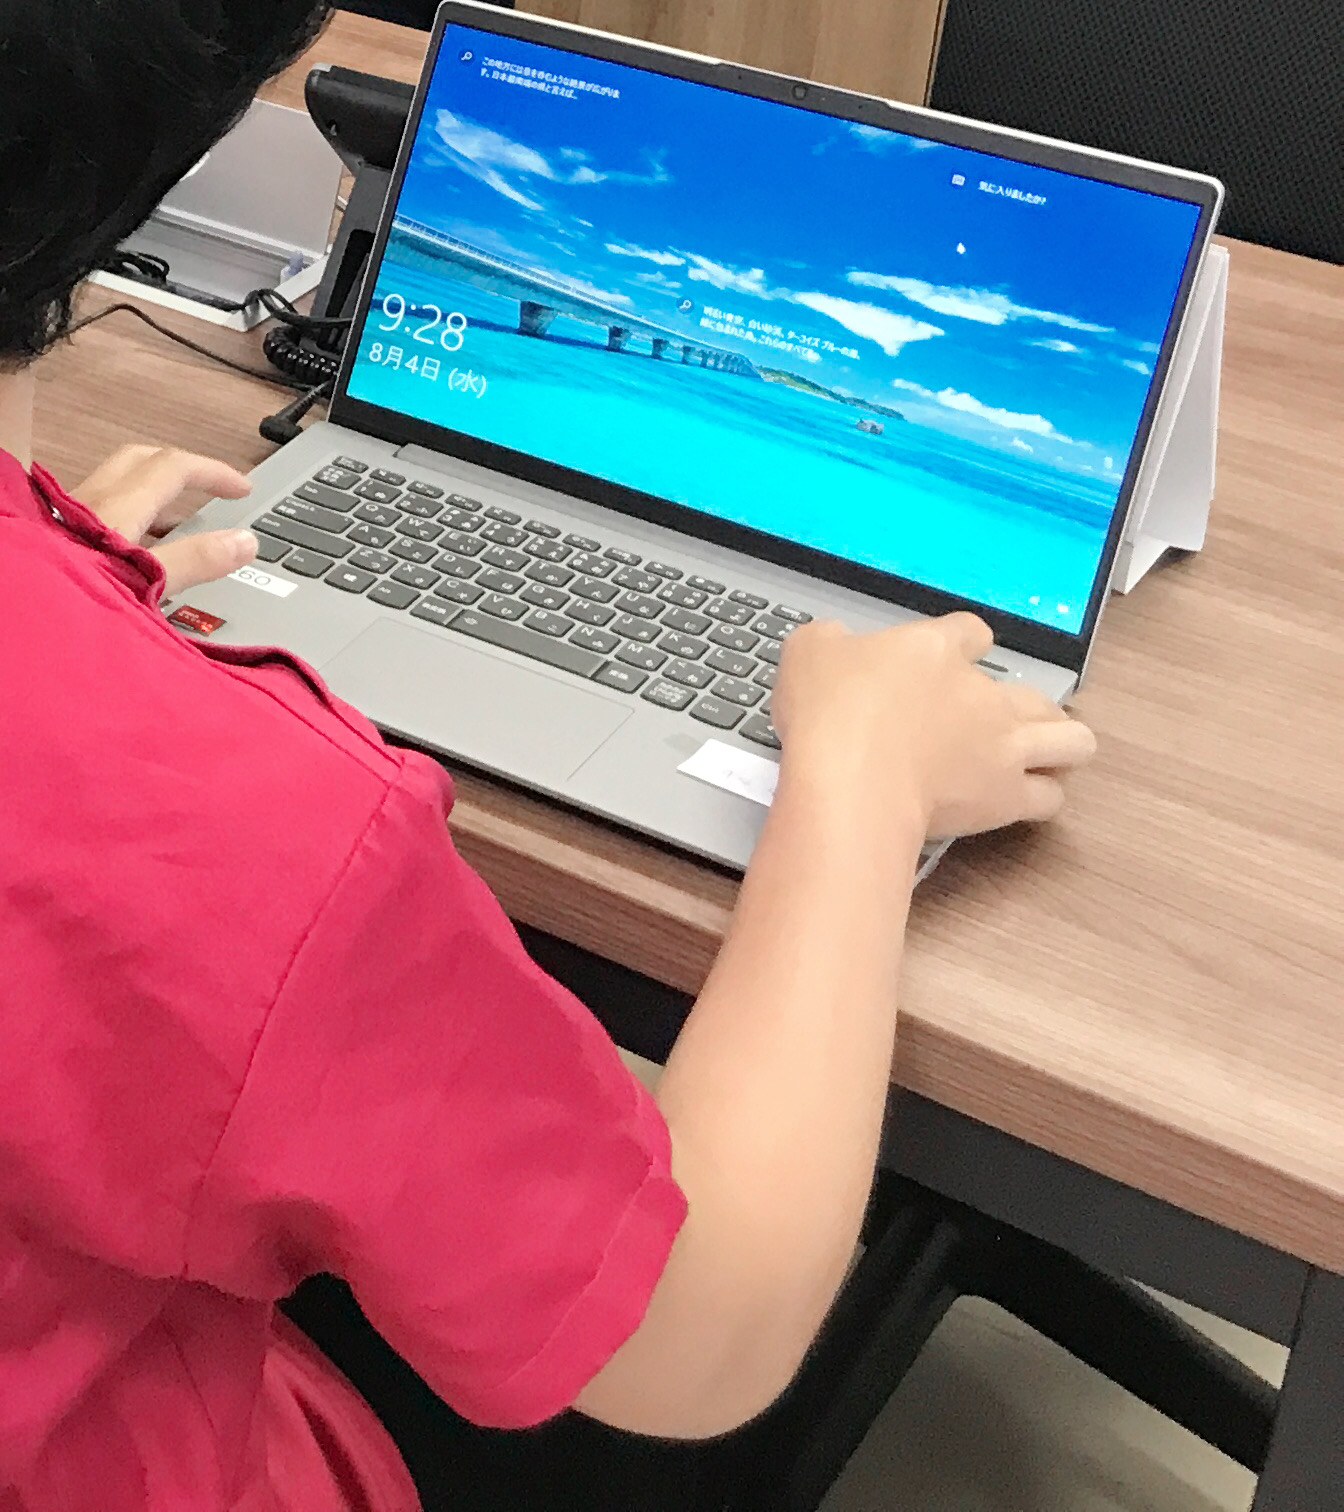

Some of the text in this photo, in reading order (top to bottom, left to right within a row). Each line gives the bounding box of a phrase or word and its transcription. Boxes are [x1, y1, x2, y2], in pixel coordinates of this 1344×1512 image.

[379, 293, 467, 351] 9:28
[369, 342, 487, 399] 8月4日 (水)
[238, 568, 272, 587] 60
